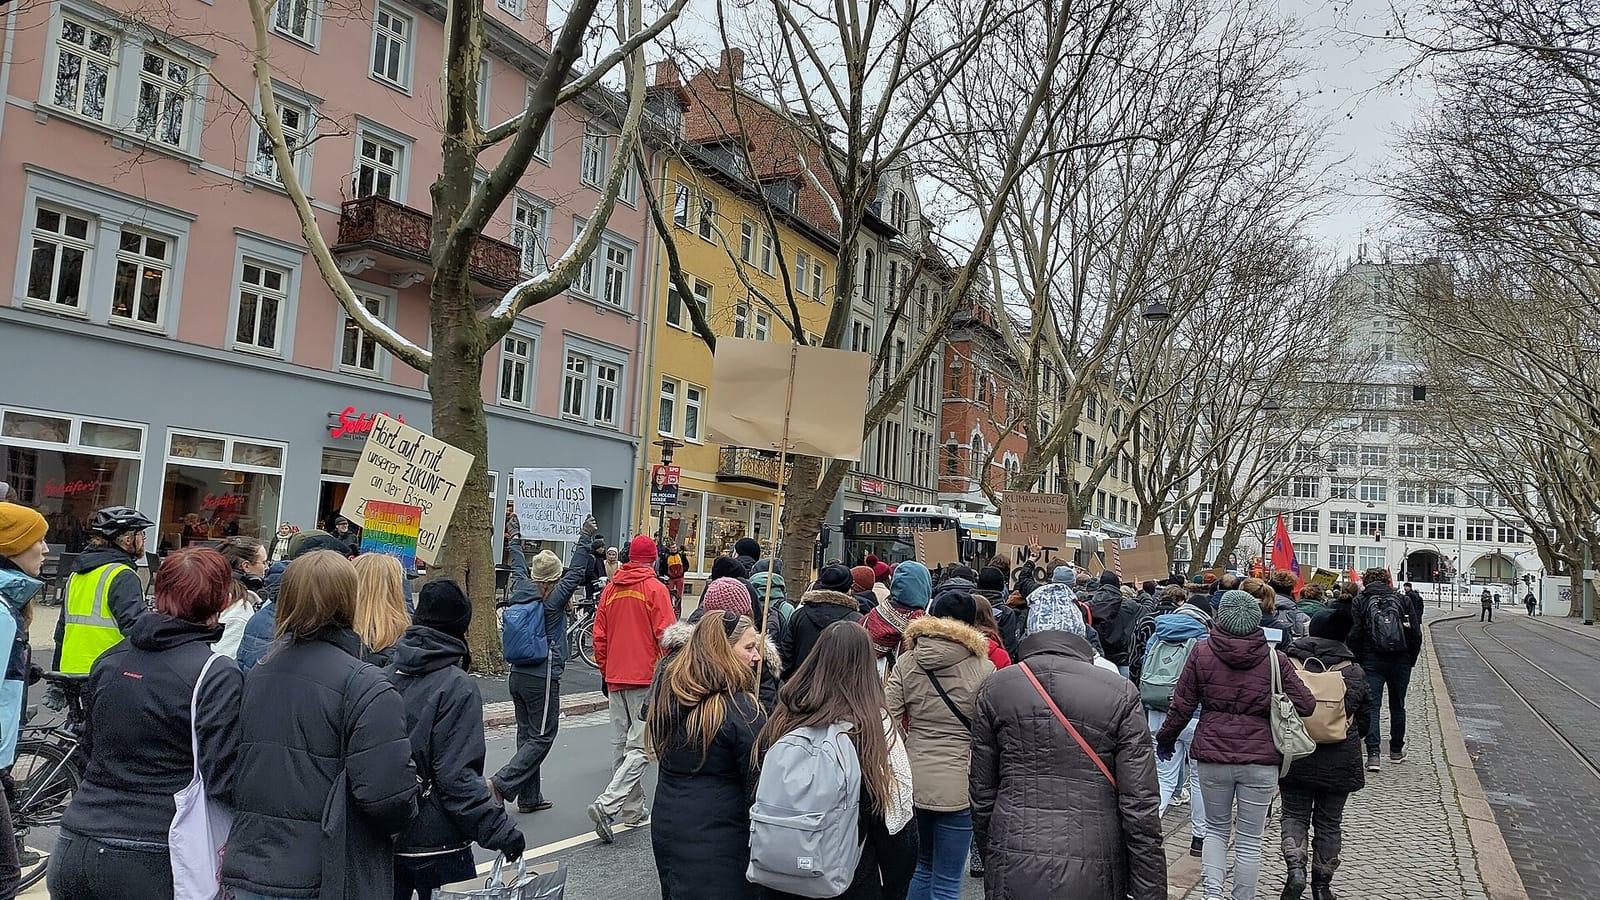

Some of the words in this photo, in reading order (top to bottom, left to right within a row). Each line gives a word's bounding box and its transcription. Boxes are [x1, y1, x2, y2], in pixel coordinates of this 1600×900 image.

[371, 417, 401, 449] Hört
[398, 435, 425, 462] auf
[419, 447, 447, 472] mit
[367, 451, 401, 475] unserer
[401, 463, 457, 501] ZUKUNFT
[370, 475, 384, 489] an
[384, 476, 401, 497] der
[403, 486, 433, 515] Börse
[518, 480, 554, 498] Rechter
[556, 500, 582, 513] KLIMA
[534, 510, 584, 526] GESELLSCHAFT
[859, 522, 872, 534] 10
[1041, 522, 1067, 535] MAUL
